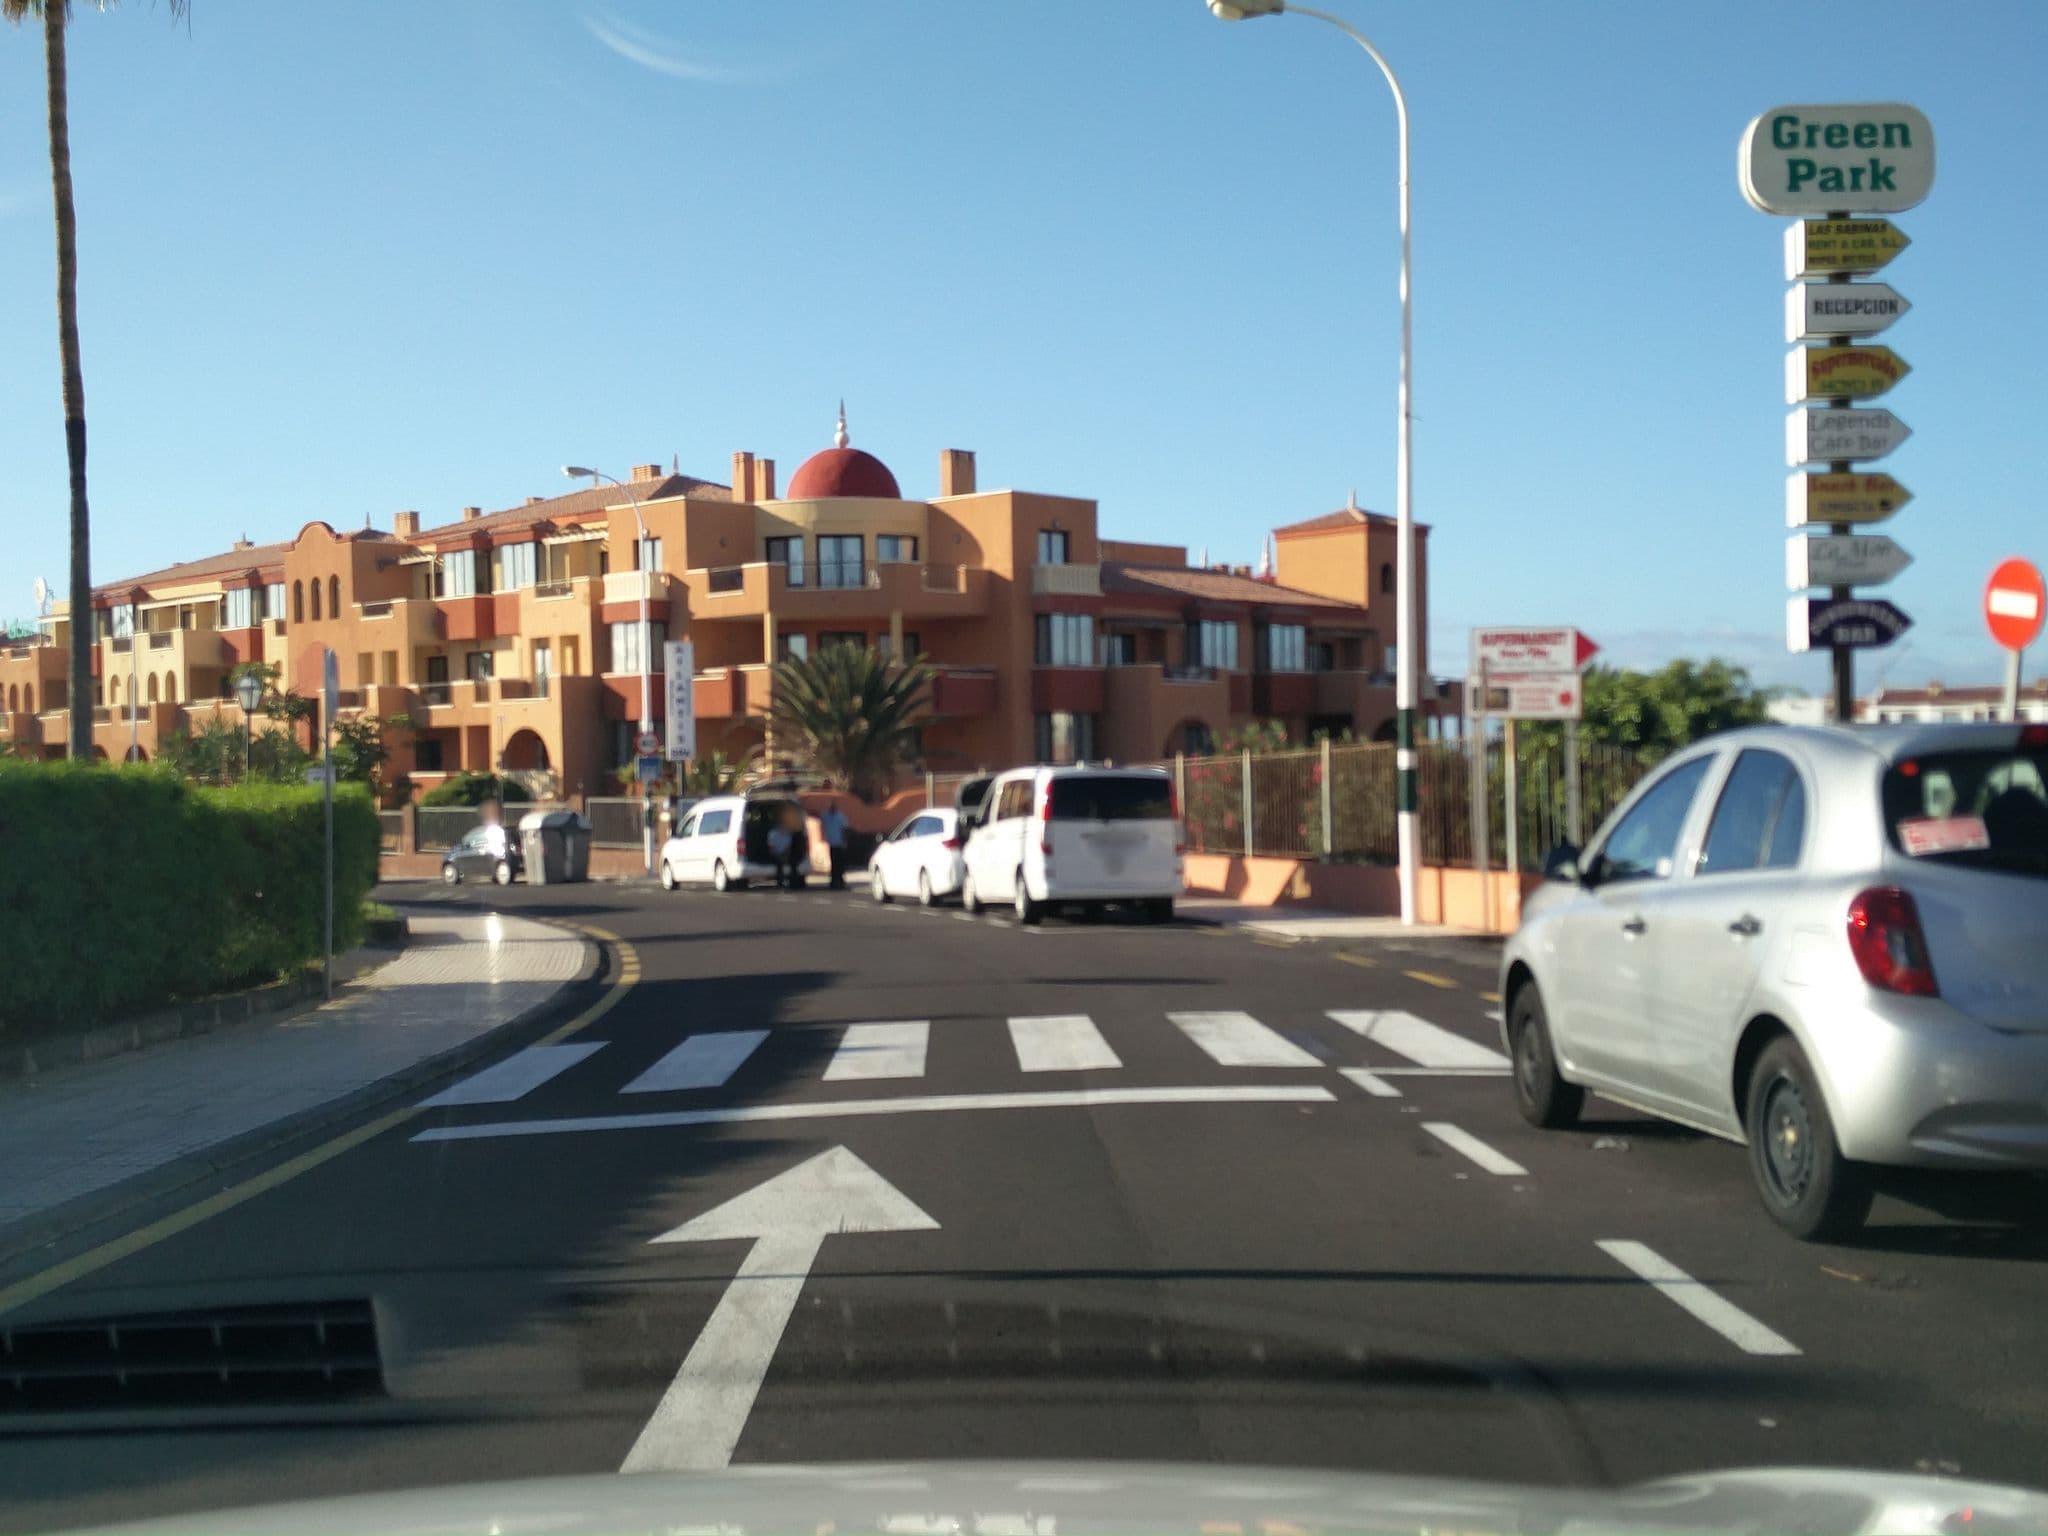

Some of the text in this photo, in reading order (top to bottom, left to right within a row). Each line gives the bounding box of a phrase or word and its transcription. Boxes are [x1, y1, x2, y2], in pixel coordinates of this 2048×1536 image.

[1771, 115, 1912, 150] Green
[1786, 158, 1898, 193] Park
[1808, 225, 1831, 235] LAS
